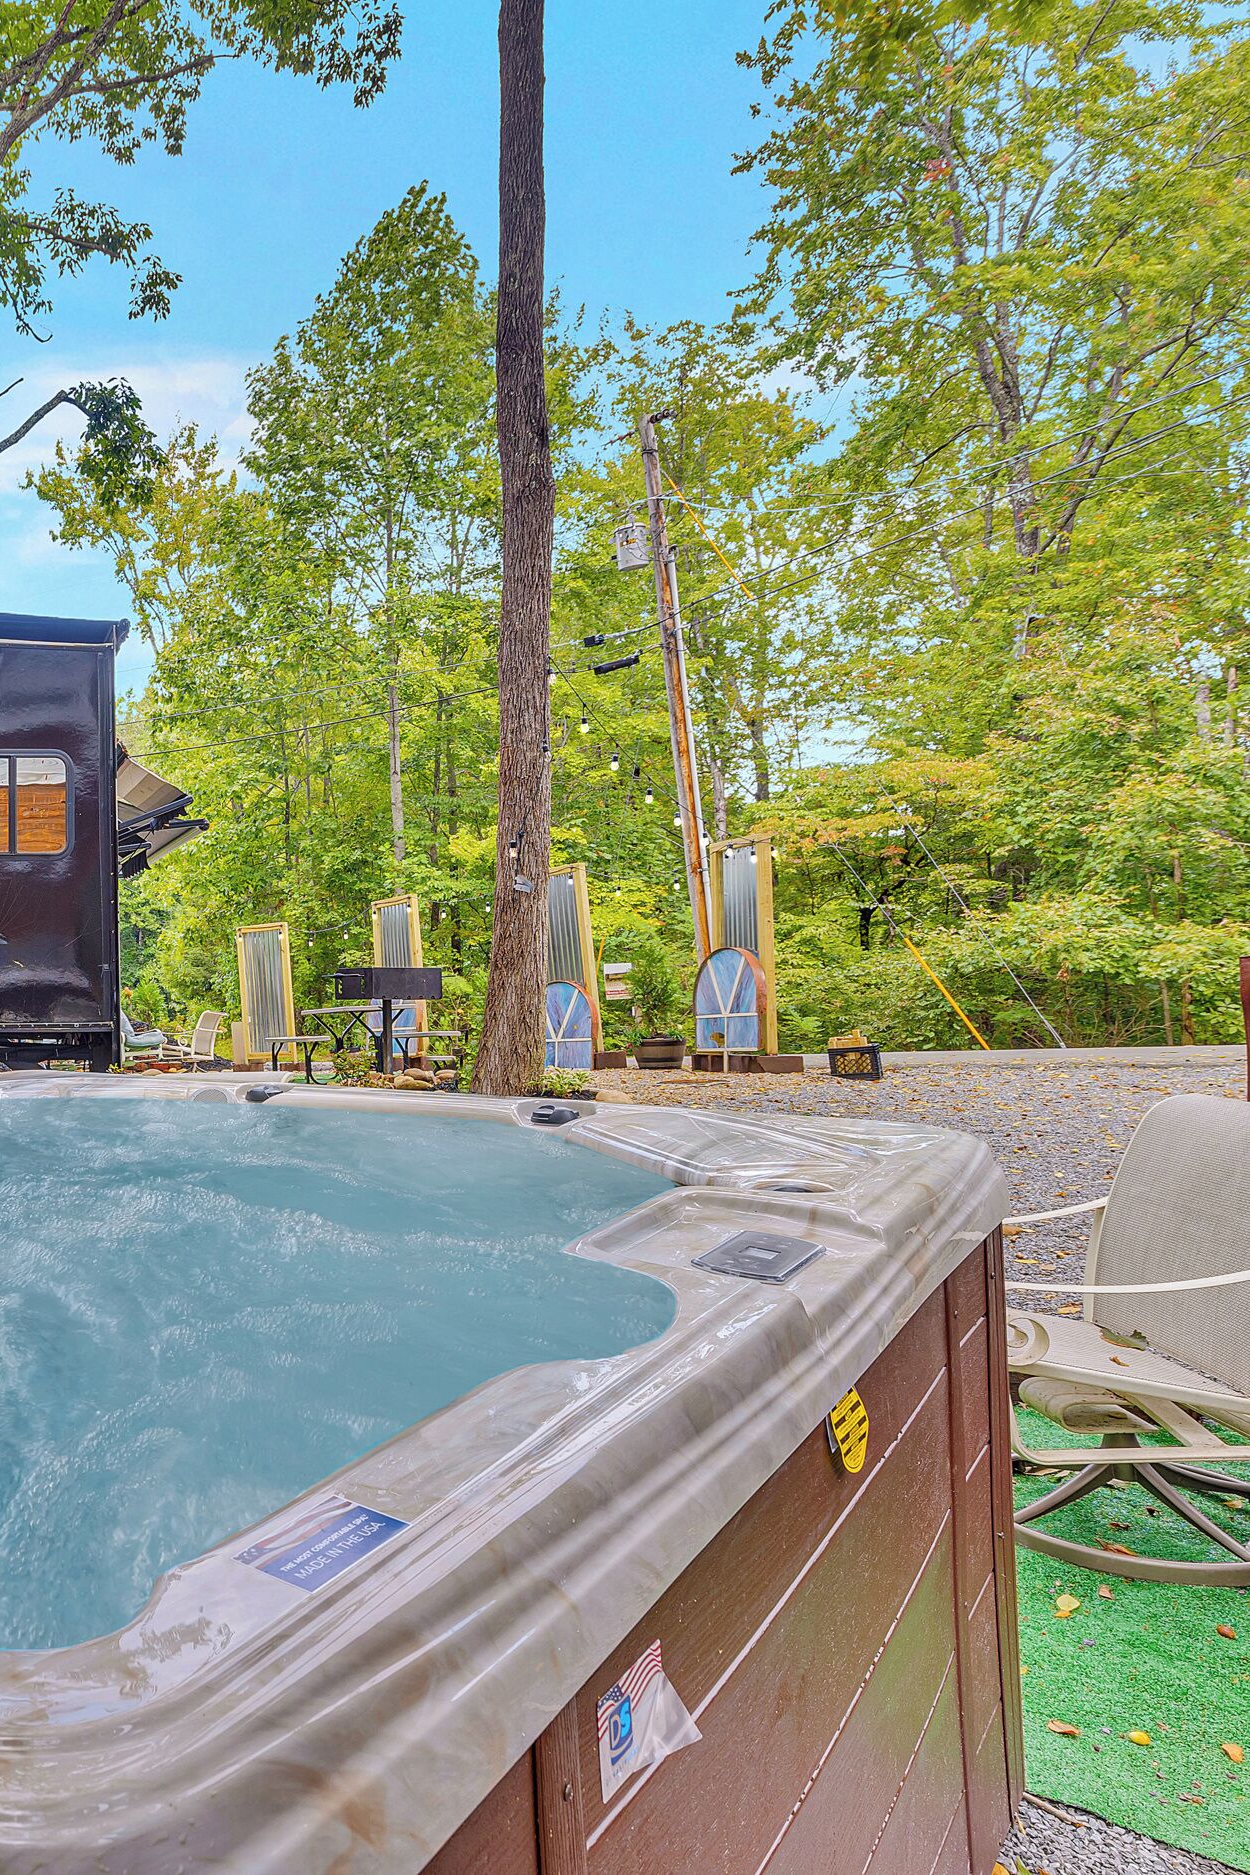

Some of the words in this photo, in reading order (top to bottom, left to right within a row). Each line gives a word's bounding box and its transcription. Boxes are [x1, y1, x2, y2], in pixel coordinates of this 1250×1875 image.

[280, 1561, 297, 1572] THE
[293, 1550, 314, 1564] MOST
[311, 1521, 356, 1552] COMFORTABLE
[294, 1555, 332, 1579] MADE
[326, 1547, 343, 1558] IN
[336, 1534, 364, 1549] THE
